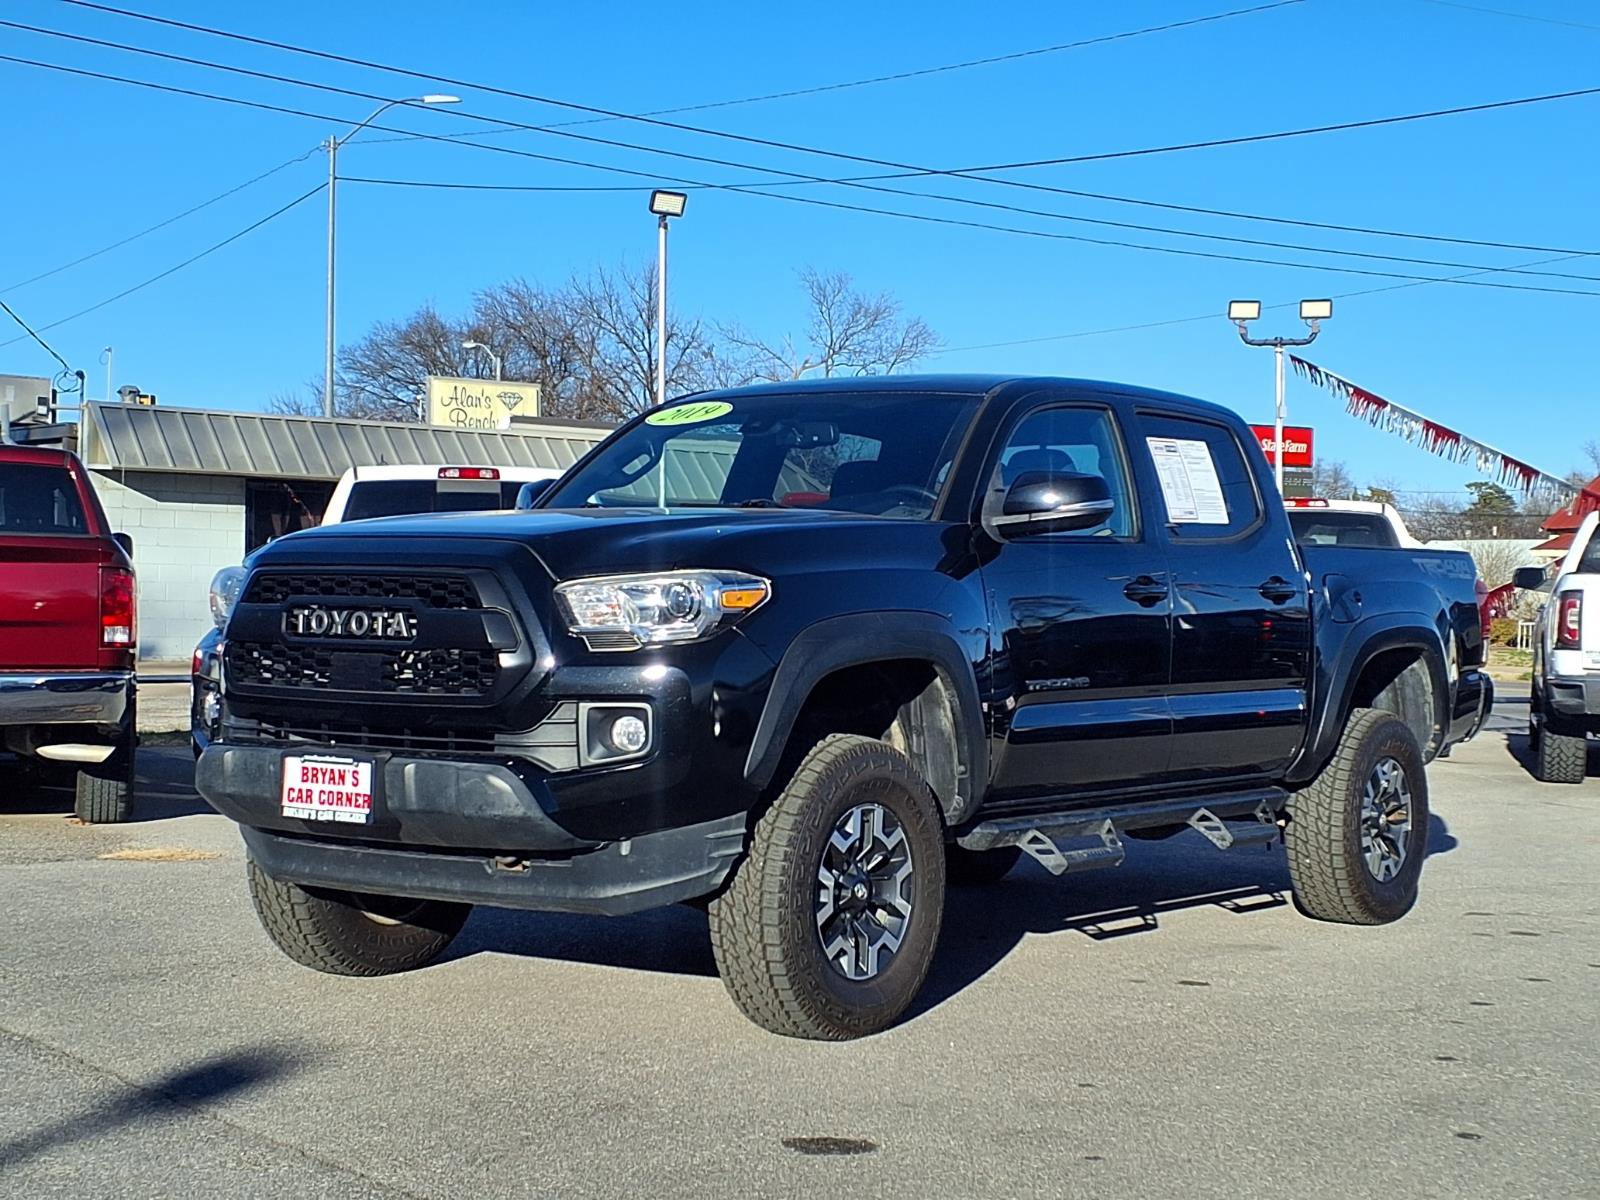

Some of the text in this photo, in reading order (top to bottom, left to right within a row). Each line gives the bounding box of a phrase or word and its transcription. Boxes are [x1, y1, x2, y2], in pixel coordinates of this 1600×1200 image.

[441, 386, 492, 409] Alan's
[293, 609, 409, 638] TOYOTA
[301, 766, 359, 787] BRYAN'S
[287, 787, 372, 809] CAR CORNER
